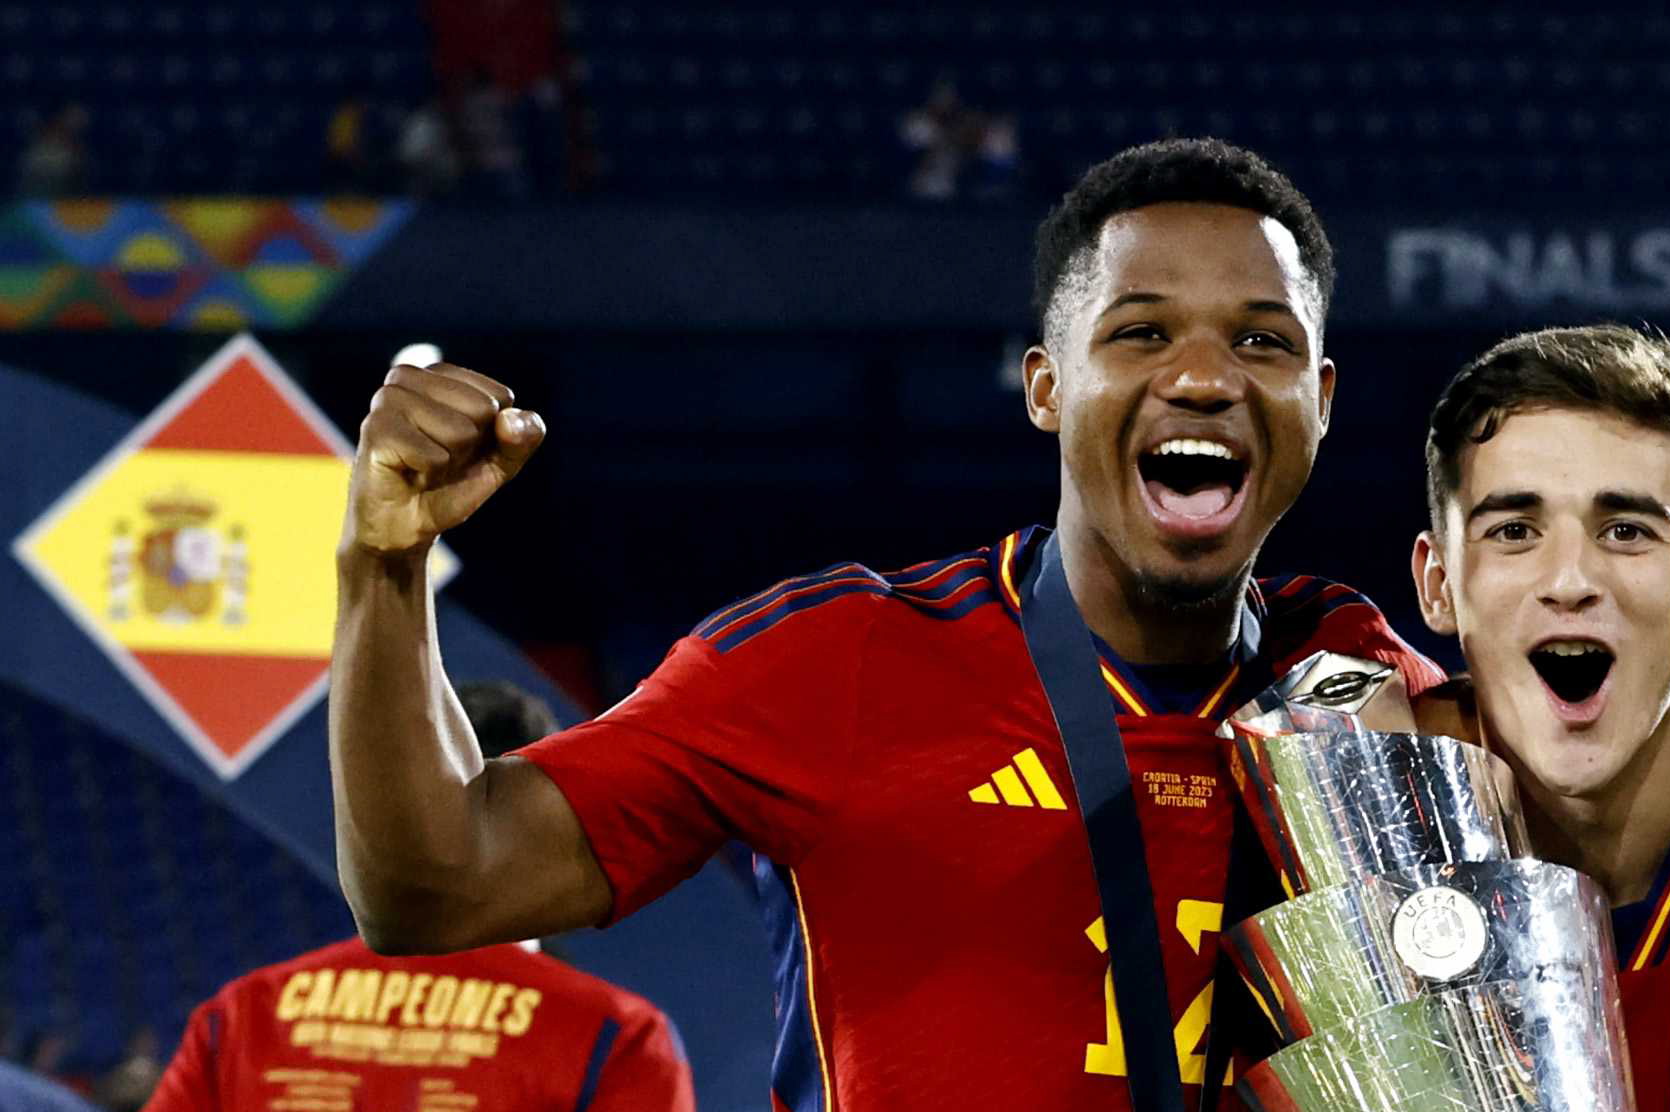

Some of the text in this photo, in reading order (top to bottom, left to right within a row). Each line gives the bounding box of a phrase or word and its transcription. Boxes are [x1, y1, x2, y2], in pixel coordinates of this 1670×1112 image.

[1162, 784, 1186, 796] JUNE
[1189, 785, 1213, 798] 2023
[1155, 794, 1207, 808] ROTTERDAM
[1403, 893, 1457, 918] UEFA
[276, 968, 542, 1036] CAMPEONES
